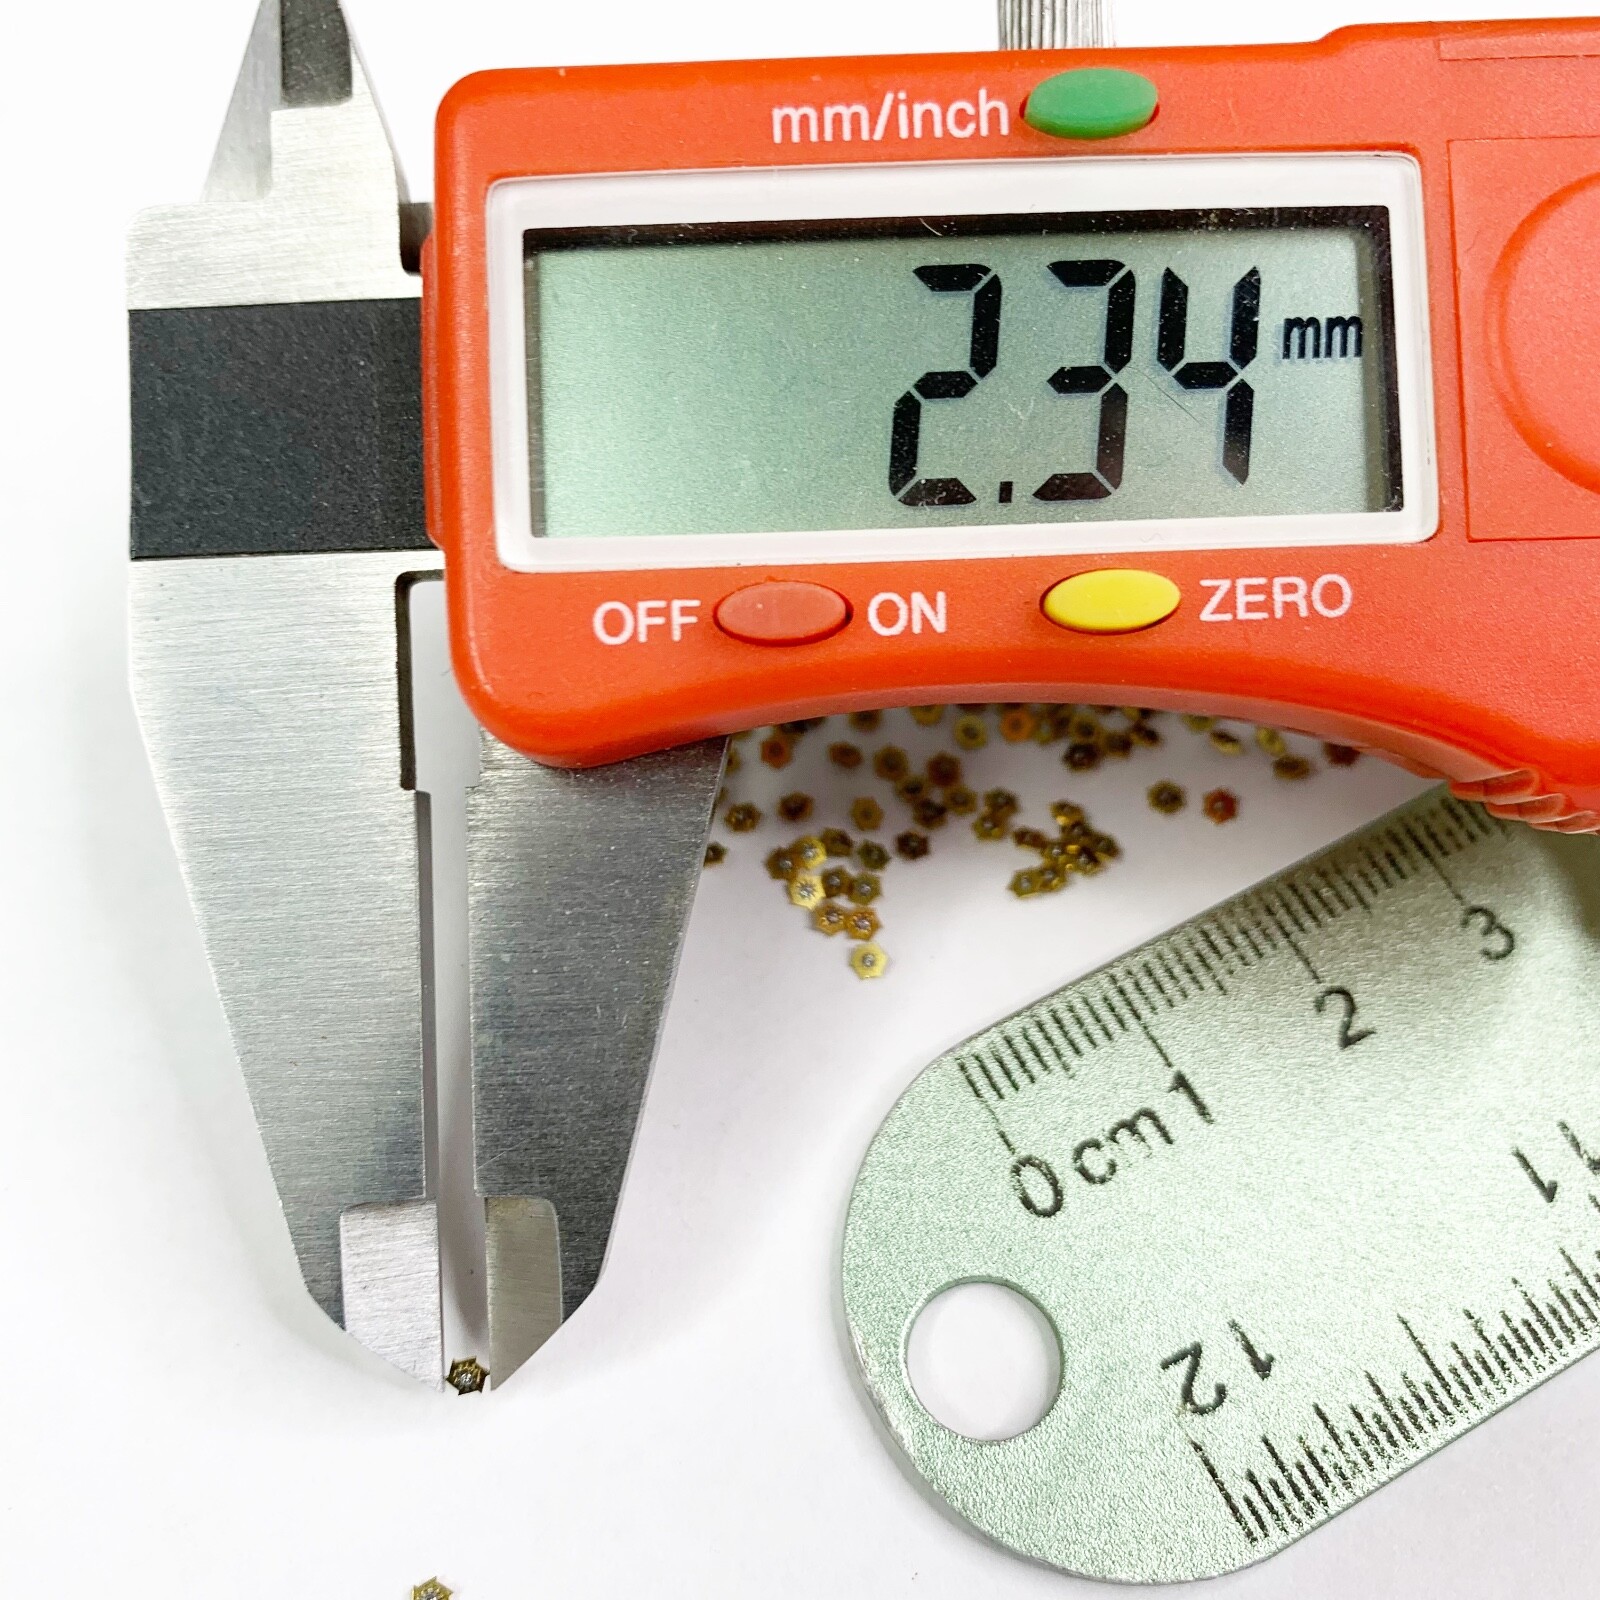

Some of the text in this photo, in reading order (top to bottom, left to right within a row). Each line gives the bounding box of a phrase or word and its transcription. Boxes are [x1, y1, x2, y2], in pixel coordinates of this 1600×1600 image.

[772, 88, 1010, 144] mm/inch
[888, 259, 1363, 507] 2.34 mm
[592, 598, 700, 645] OFF
[866, 590, 949, 635] ON
[1199, 573, 1354, 622] ZERO
[1011, 905, 1516, 1217] 0 cm 1 2 3
[1160, 1317, 1275, 1415] 12
